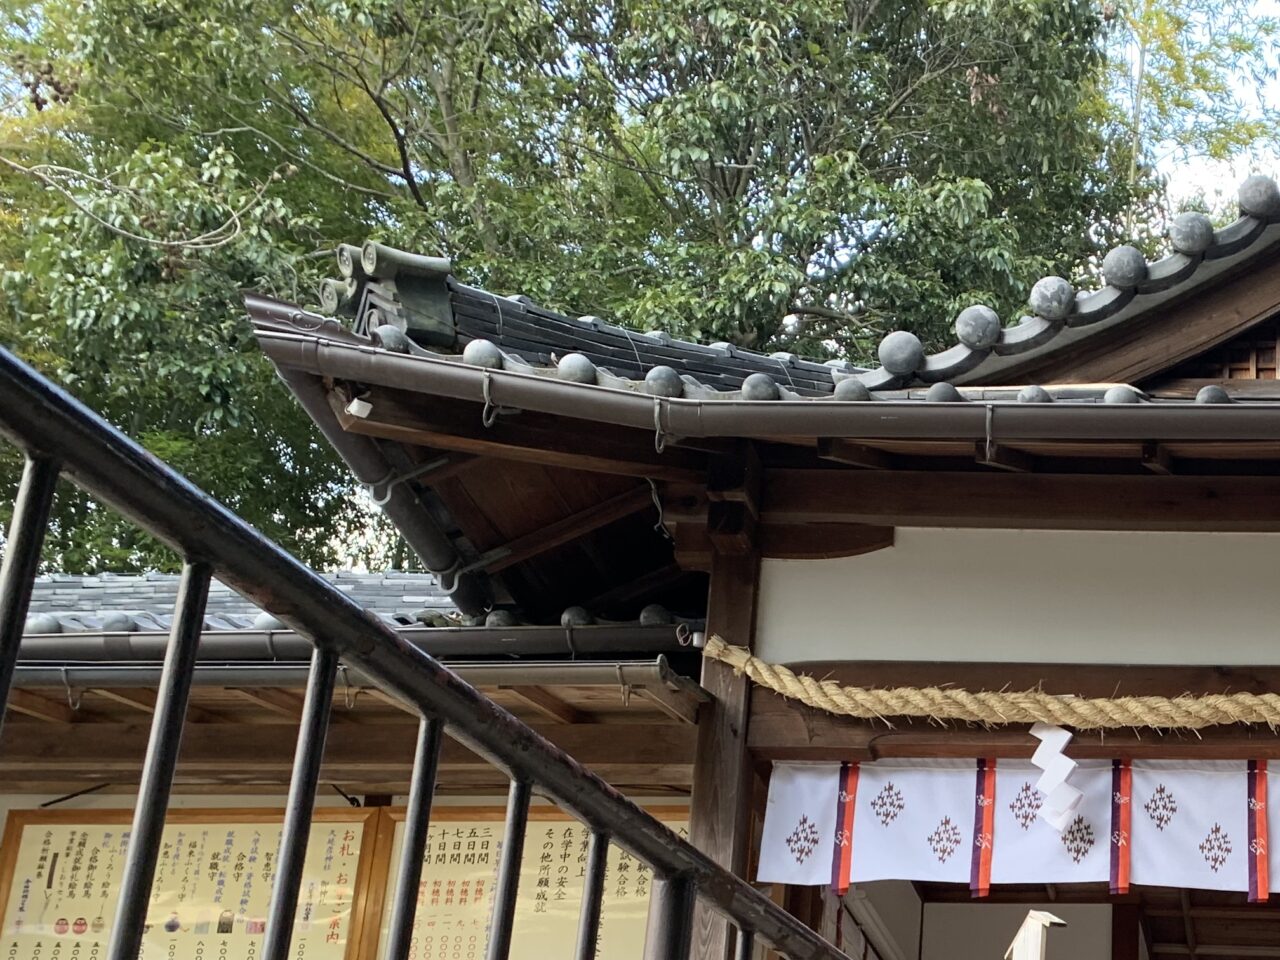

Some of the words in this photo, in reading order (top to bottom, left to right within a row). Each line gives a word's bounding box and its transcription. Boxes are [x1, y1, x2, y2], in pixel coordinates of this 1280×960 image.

[434, 828, 450, 865] 十日間
[449, 828, 464, 865] 七日間
[463, 828, 479, 865] 五日間
[476, 828, 493, 864] 三日間
[553, 827, 574, 900] 在学中の安全
[207, 851, 222, 882] 就職守
[233, 851, 247, 882] 合格守
[534, 828, 555, 913] その他所願成就
